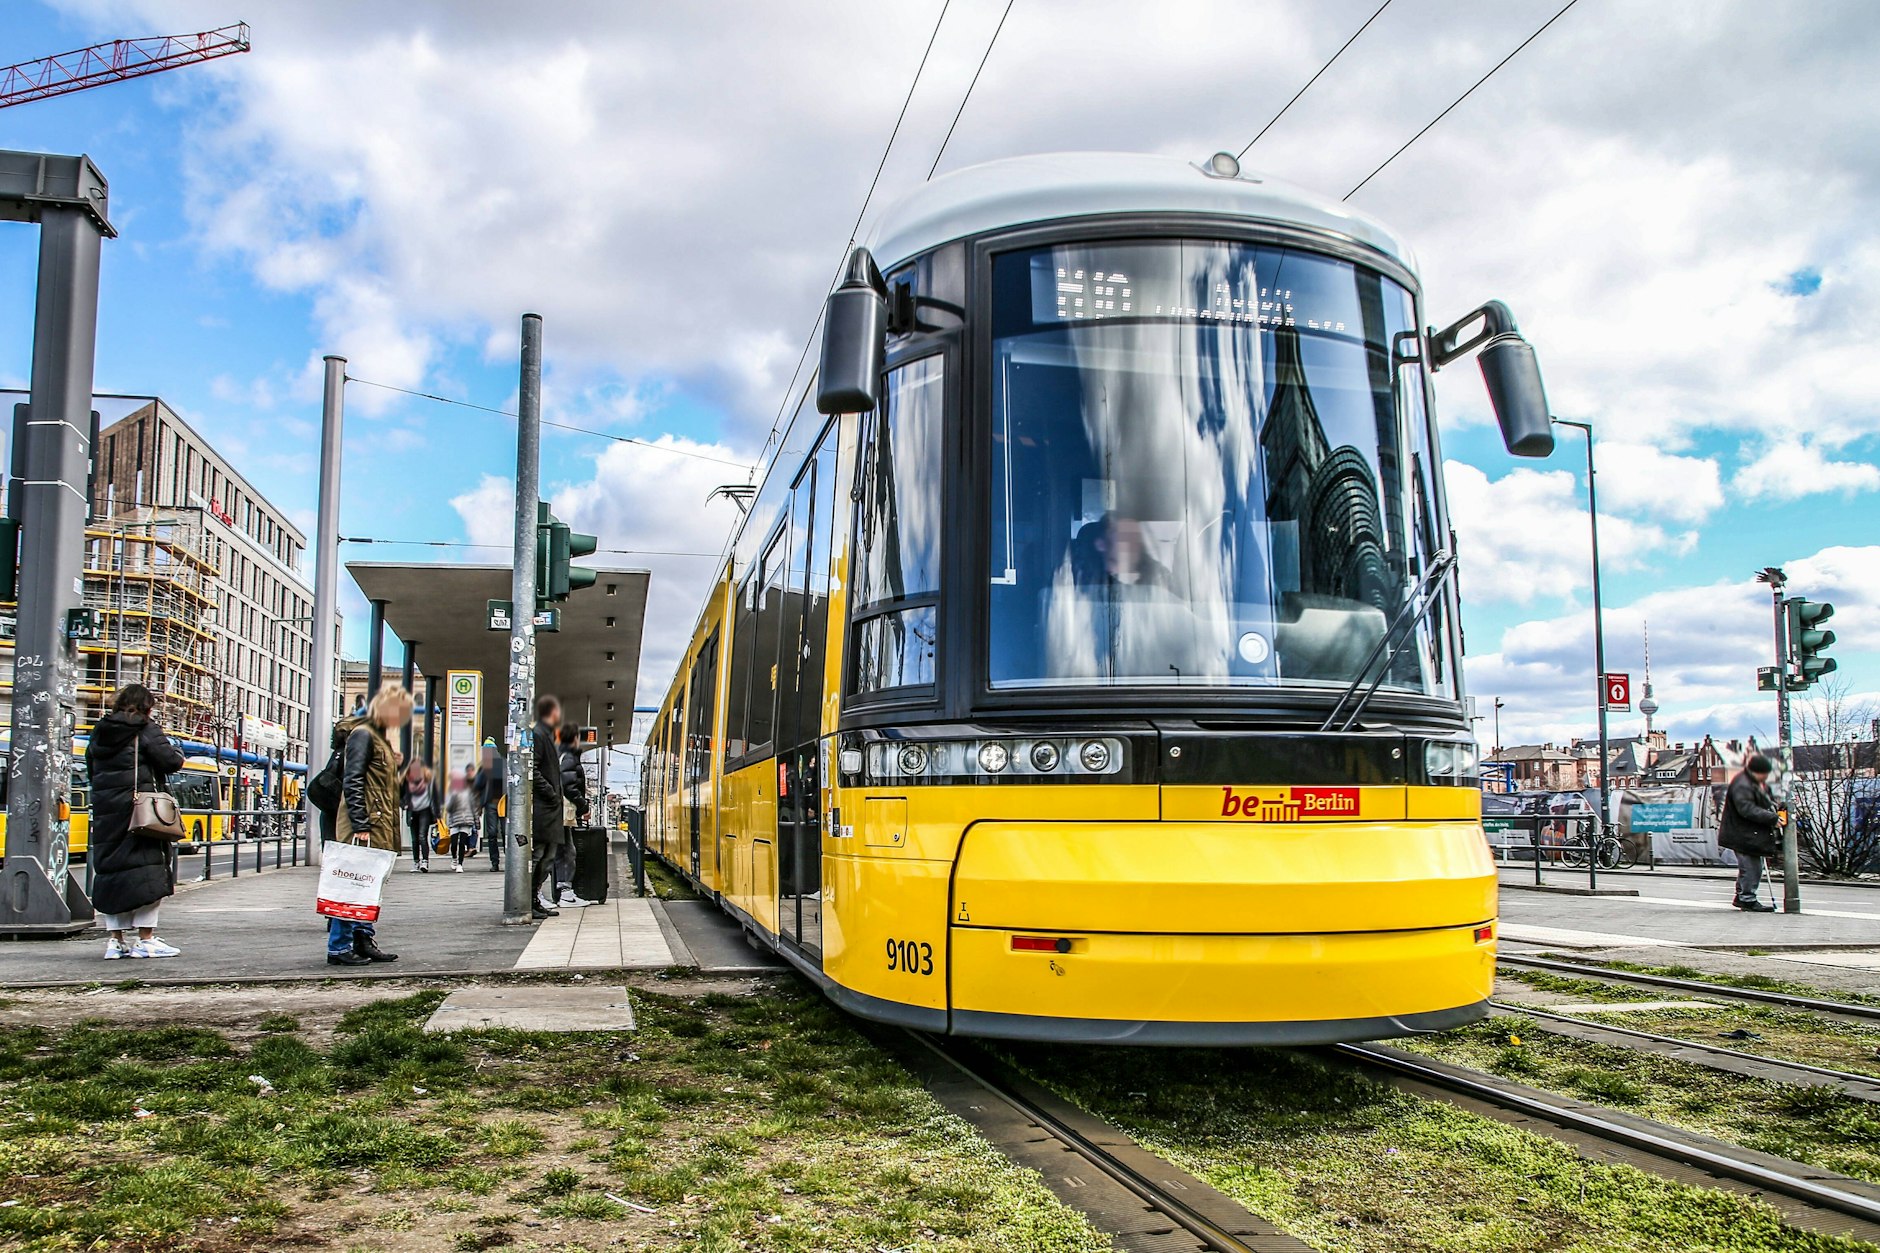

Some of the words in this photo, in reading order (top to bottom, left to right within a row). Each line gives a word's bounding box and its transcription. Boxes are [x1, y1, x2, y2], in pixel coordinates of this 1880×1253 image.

[1221, 786, 1260, 817] be
[1304, 793, 1355, 811] Berlin
[886, 938, 934, 976] 9103
